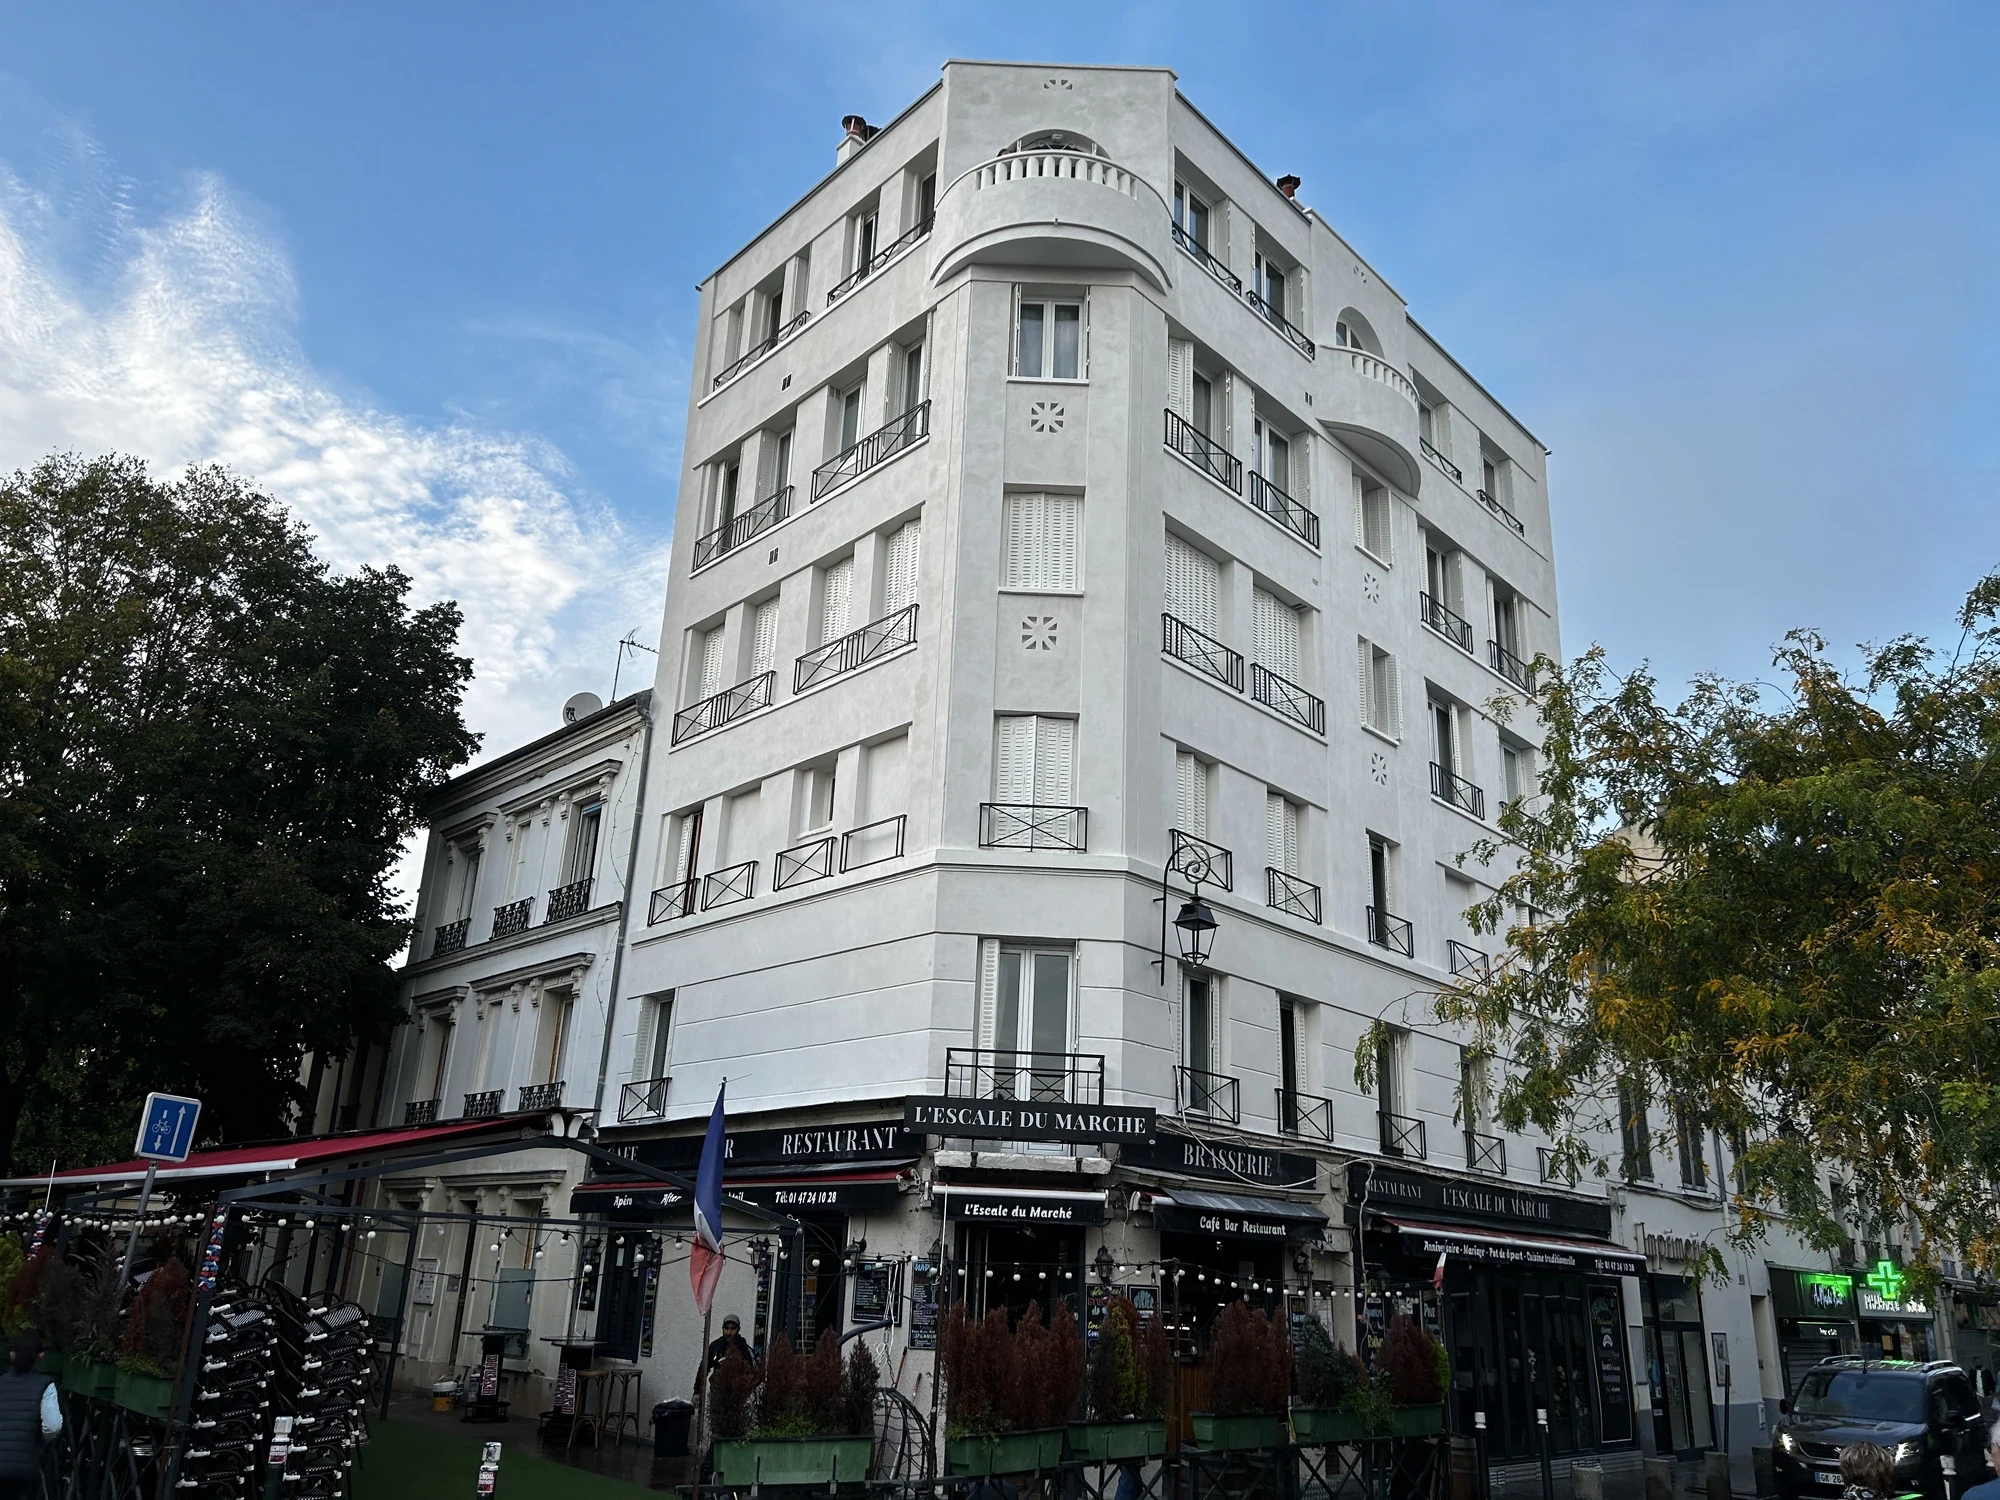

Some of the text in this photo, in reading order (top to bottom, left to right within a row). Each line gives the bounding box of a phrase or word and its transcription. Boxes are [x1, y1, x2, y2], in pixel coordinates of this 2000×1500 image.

[915, 1106, 1146, 1134] L'ESCALE DU MARCHE
[782, 1127, 897, 1155] RESTAURANT
[1183, 1143, 1273, 1177] BRASSERIE
[614, 1192, 682, 1208] Apéro After
[789, 1192, 796, 1203] 01
[798, 1192, 807, 1204] 47
[807, 1192, 817, 1204] 24
[818, 1192, 826, 1203] 10
[827, 1191, 837, 1203] 28
[1368, 1179, 1551, 1219] RESTAURANT L'ESCALE DU MARCHE
[1011, 1205, 1026, 1217] du
[1030, 1206, 1072, 1219] Marché
[1200, 1216, 1286, 1236] Café Bar Restaurant
[1424, 1240, 1459, 1254] Annivesaire
[1463, 1244, 1485, 1258] Mariage
[1489, 1247, 1498, 1259] Pot
[1499, 1248, 1506, 1259] de
[1526, 1251, 1544, 1263] Cuisine
[481, 1354, 499, 1395] DESPERADOS
[562, 1369, 576, 1414] DESPERADOS
